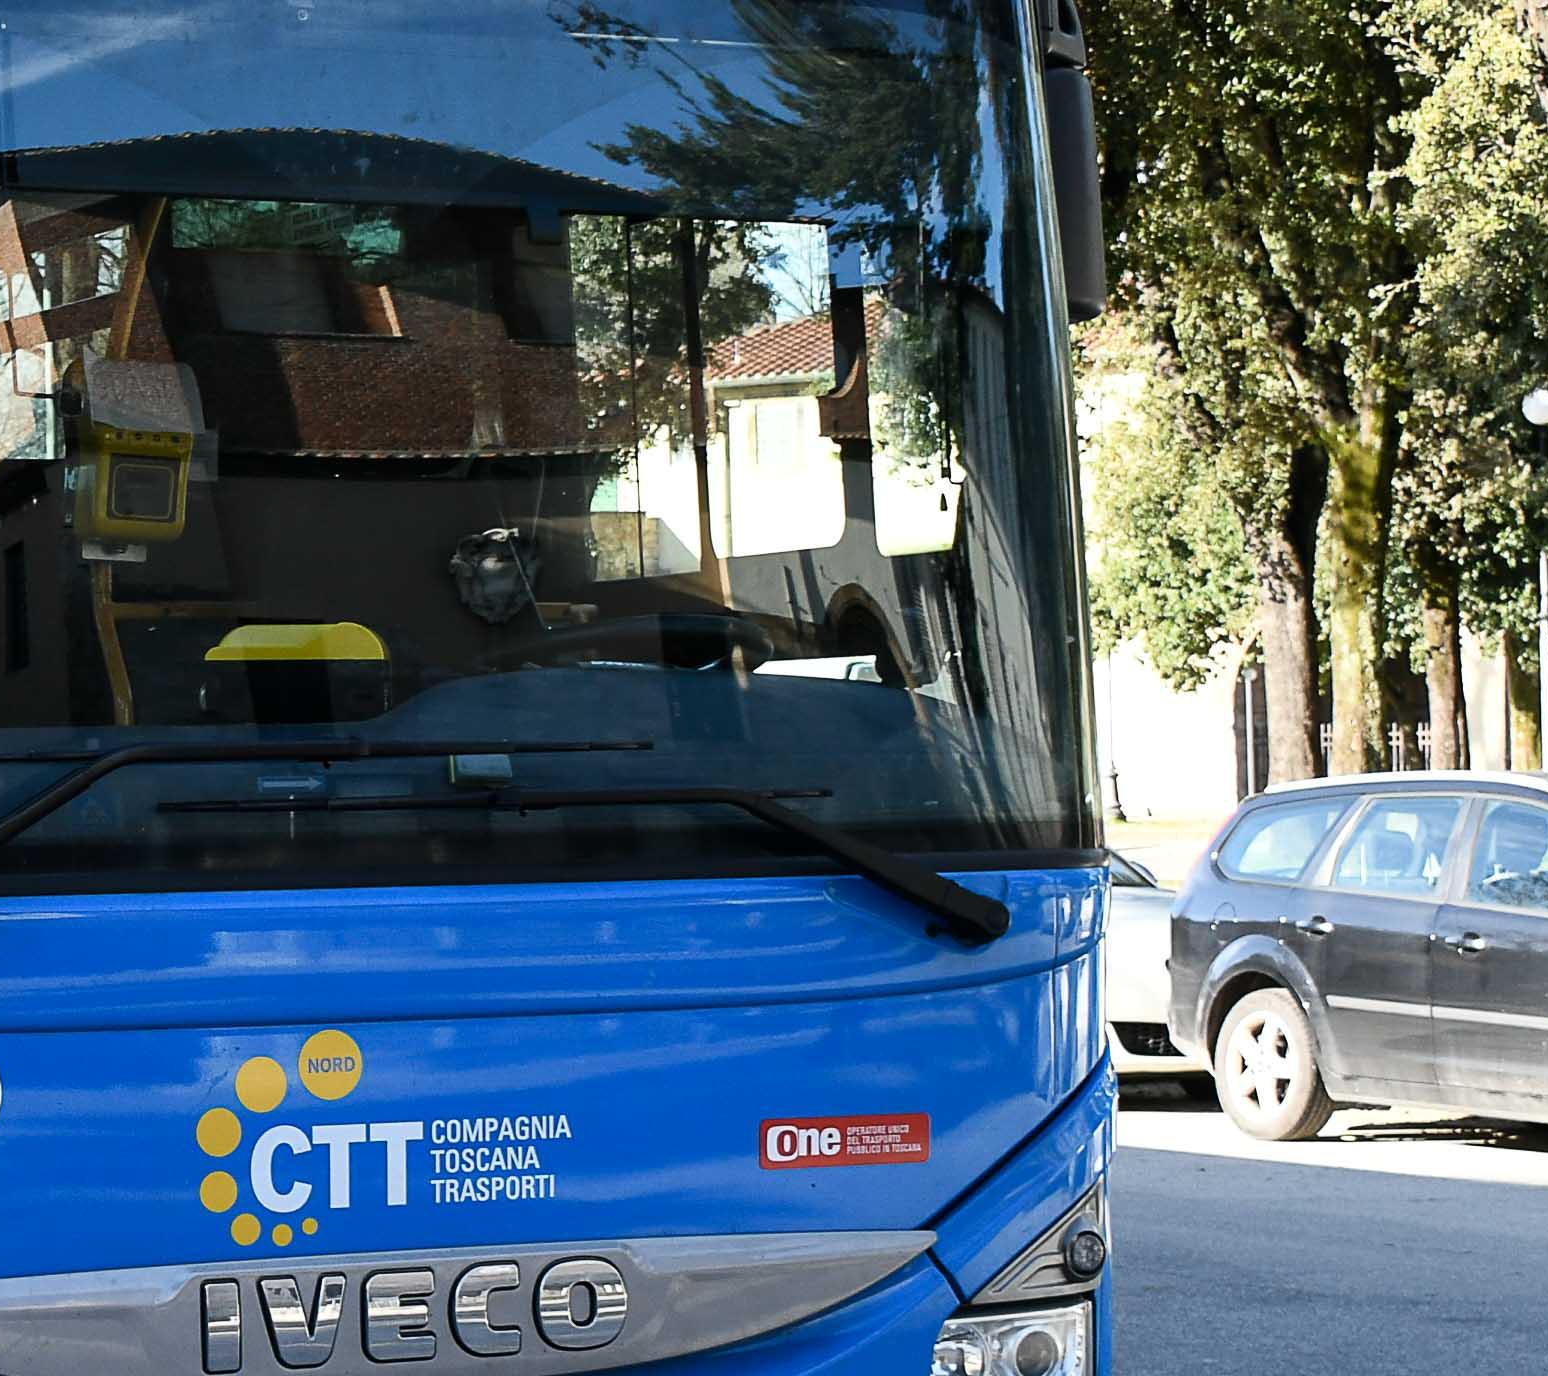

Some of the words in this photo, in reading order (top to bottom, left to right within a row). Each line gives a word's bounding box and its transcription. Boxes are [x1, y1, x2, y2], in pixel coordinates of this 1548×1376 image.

[307, 1056, 356, 1074] NORD
[429, 1114, 572, 1145] COMPAGNIA
[766, 1125, 841, 1162] One
[250, 1120, 424, 1214] CTT
[429, 1145, 541, 1174] TOSCANA
[429, 1174, 556, 1204] TRASPORTI
[200, 1254, 628, 1376] IVECO
